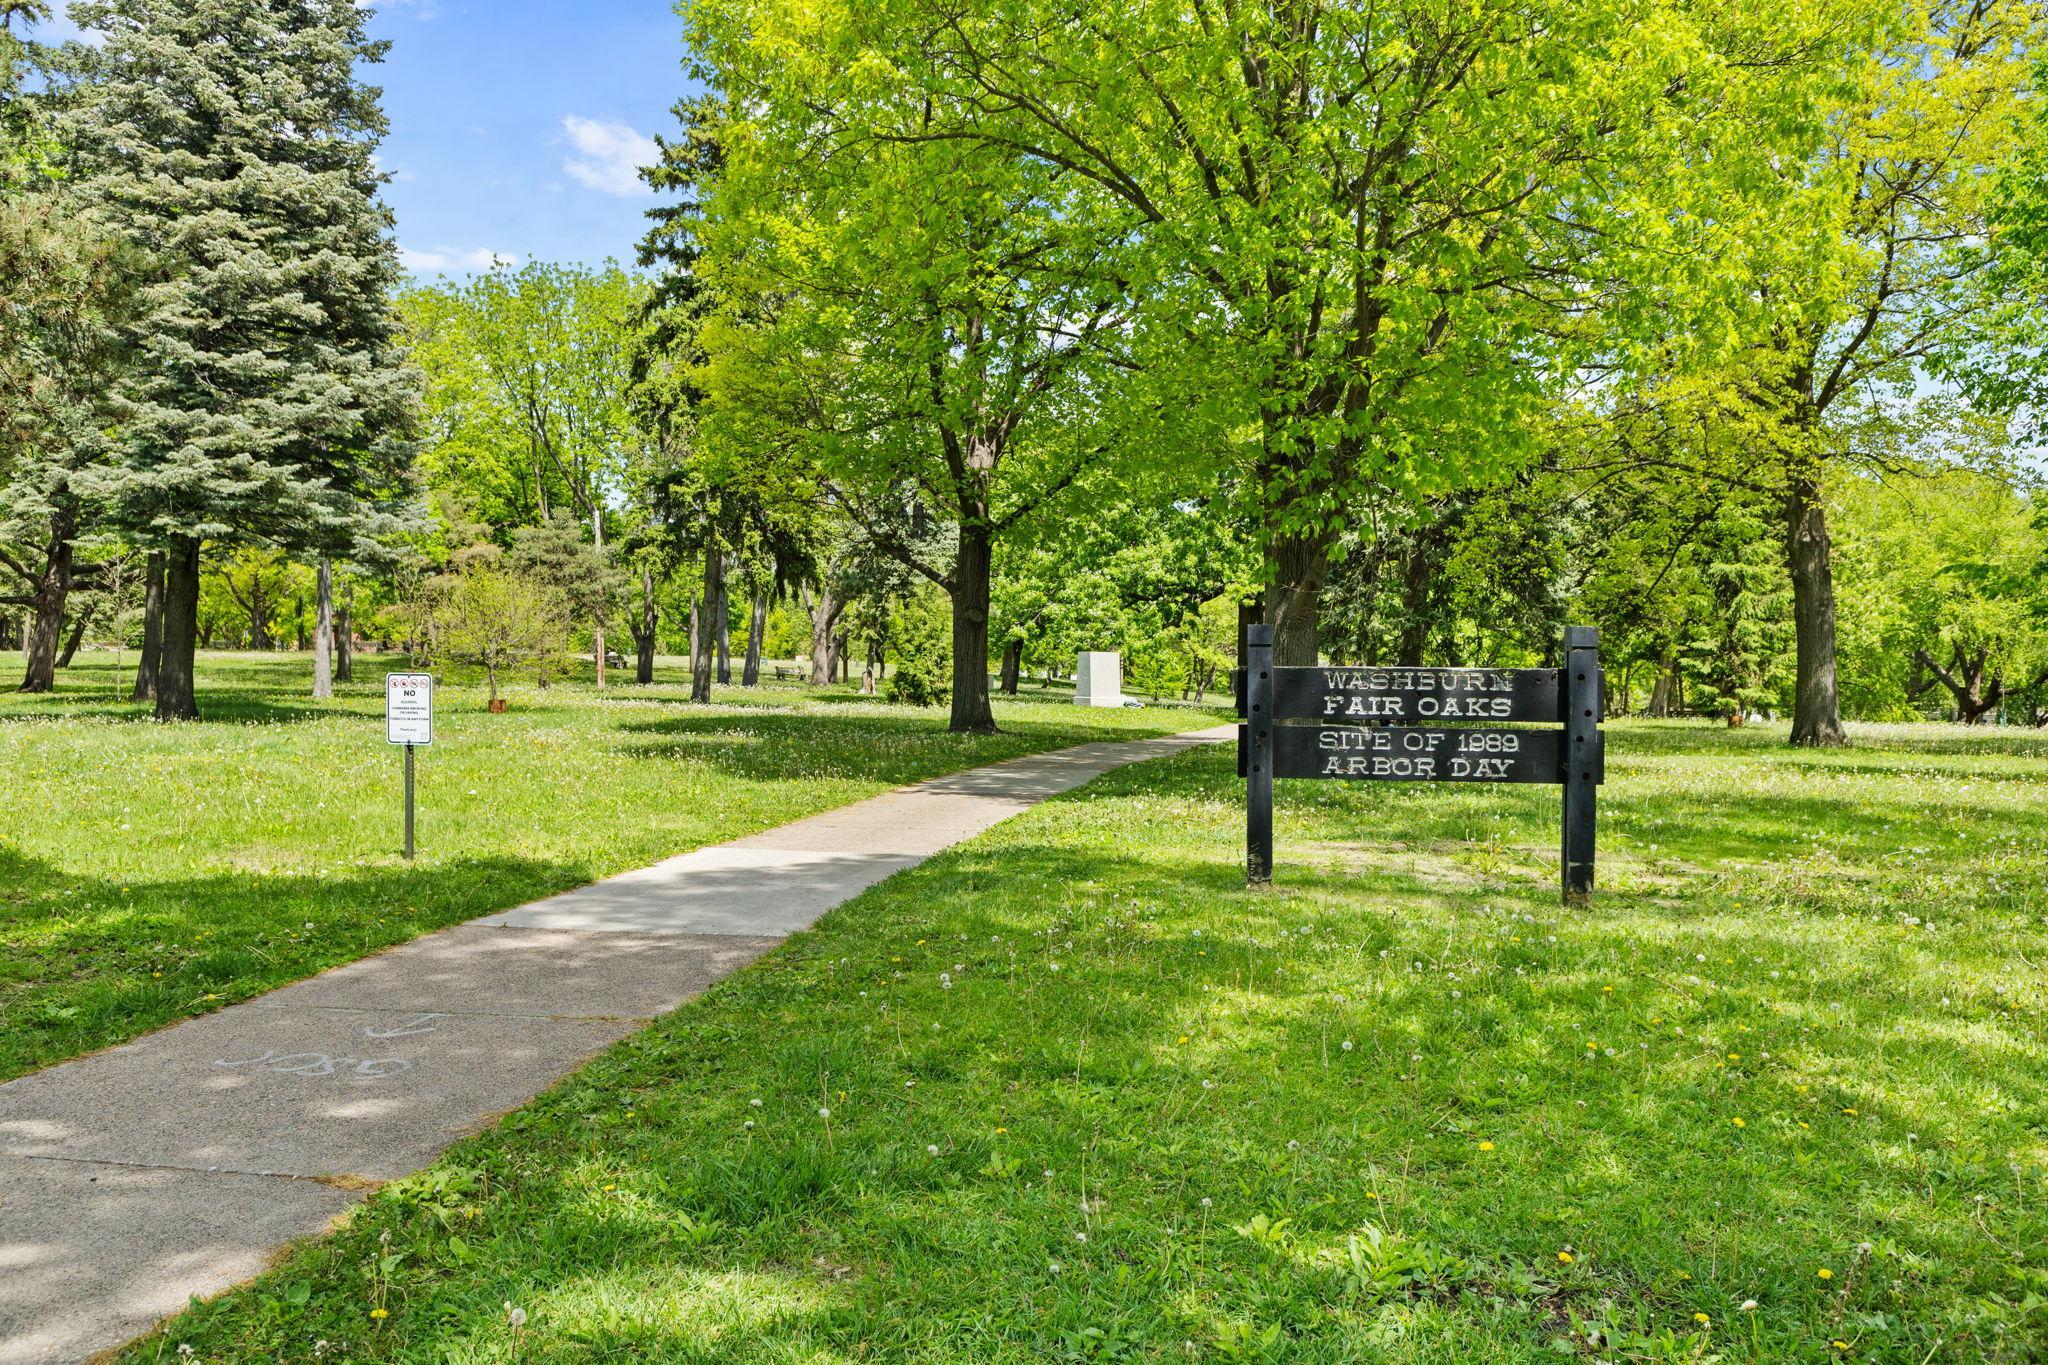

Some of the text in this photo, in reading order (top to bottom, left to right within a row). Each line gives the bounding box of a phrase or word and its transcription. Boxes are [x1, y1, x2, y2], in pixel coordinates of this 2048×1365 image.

[1324, 671, 1514, 691] WASHBURN
[1323, 696, 1512, 716] FAIR OAKS
[1319, 732, 1520, 752] SITE OF 1989
[1322, 757, 1515, 777] ARBOR DAY
